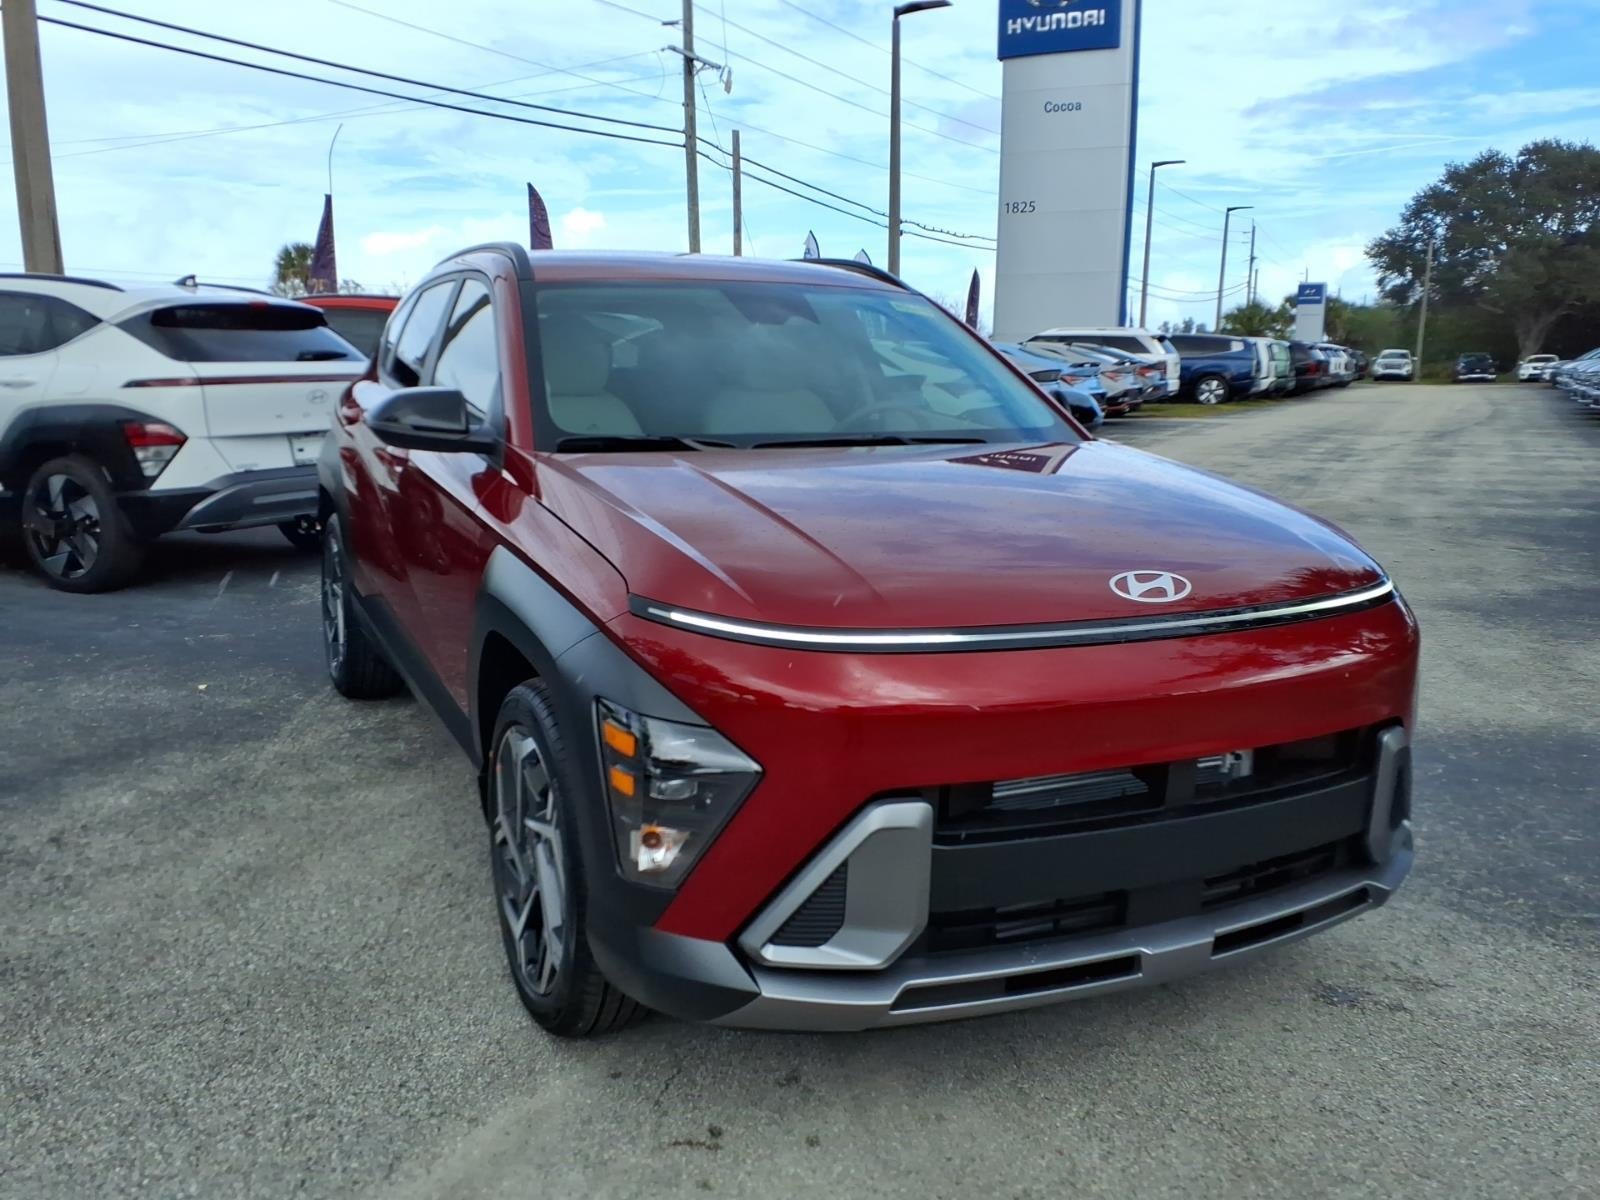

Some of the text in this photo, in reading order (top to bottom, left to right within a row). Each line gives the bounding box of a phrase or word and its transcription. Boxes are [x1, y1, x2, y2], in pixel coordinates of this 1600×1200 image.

[1007, 9, 1106, 34] HYUNDAI
[1044, 101, 1082, 113] Cocoa
[1004, 201, 1036, 214] 1825
